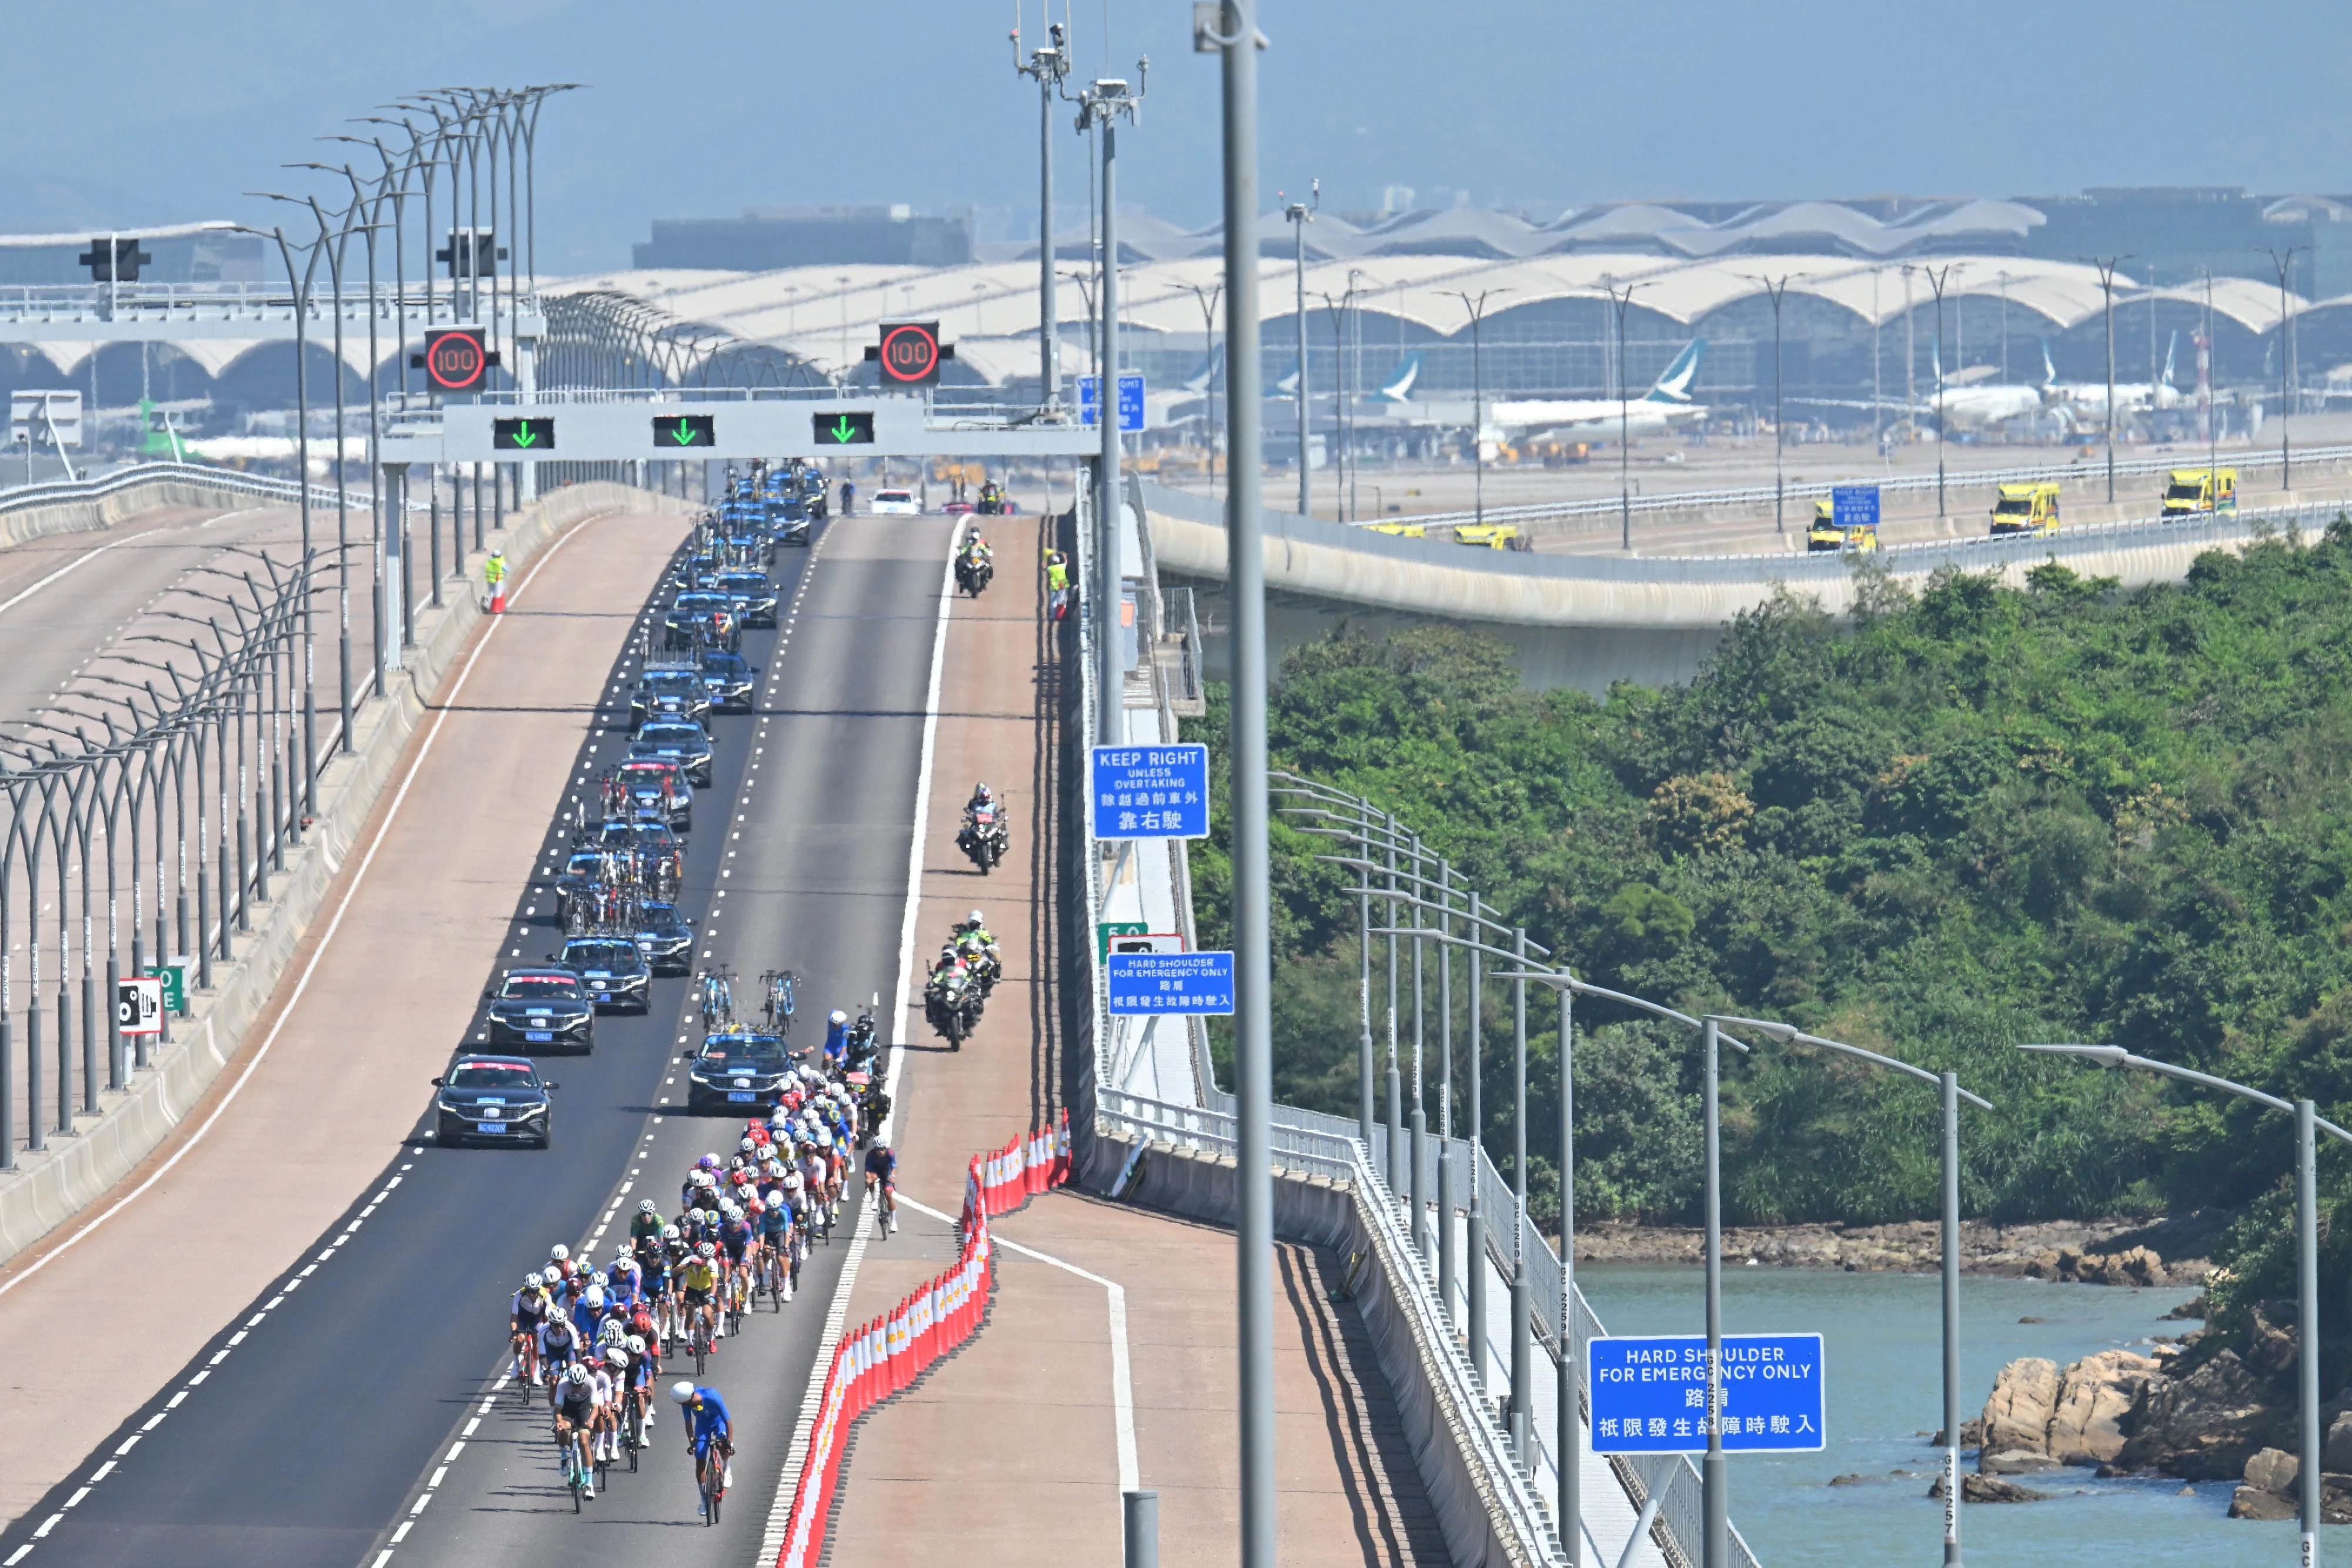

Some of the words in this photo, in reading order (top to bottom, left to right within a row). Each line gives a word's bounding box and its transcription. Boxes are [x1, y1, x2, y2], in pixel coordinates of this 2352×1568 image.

[438, 349, 475, 372] 100
[892, 342, 928, 365] 100
[1100, 753, 1141, 767] KEEP
[1149, 751, 1198, 765] RIGHT
[1127, 767, 1171, 778] UNLESS
[1114, 778, 1185, 790] OVERTAKING
[1118, 810, 1182, 830] 靠右駛
[1128, 959, 1155, 968] HARD
[1159, 958, 1214, 967] SHOULDER
[1113, 969, 1134, 978] FOR
[1136, 968, 1198, 977] EMERGENCY
[1201, 968, 1228, 977] ONLY
[1160, 979, 1184, 991] 路肩
[1440, 1088, 1445, 1102] GC
[1470, 1141, 1475, 1155] GC
[1514, 1202, 1519, 1218] GC
[1561, 1267, 1566, 1285] GC
[1626, 1349, 1676, 1363] HARD
[1684, 1348, 1785, 1362] SHULDER
[1599, 1368, 1635, 1382] FOR
[1642, 1365, 1757, 1382] EMERGNCY
[1763, 1364, 1811, 1379] ONLY
[1708, 1356, 1713, 1376] GC
[1945, 1455, 1952, 1477] GC
[2301, 1541, 2310, 1567] GC
